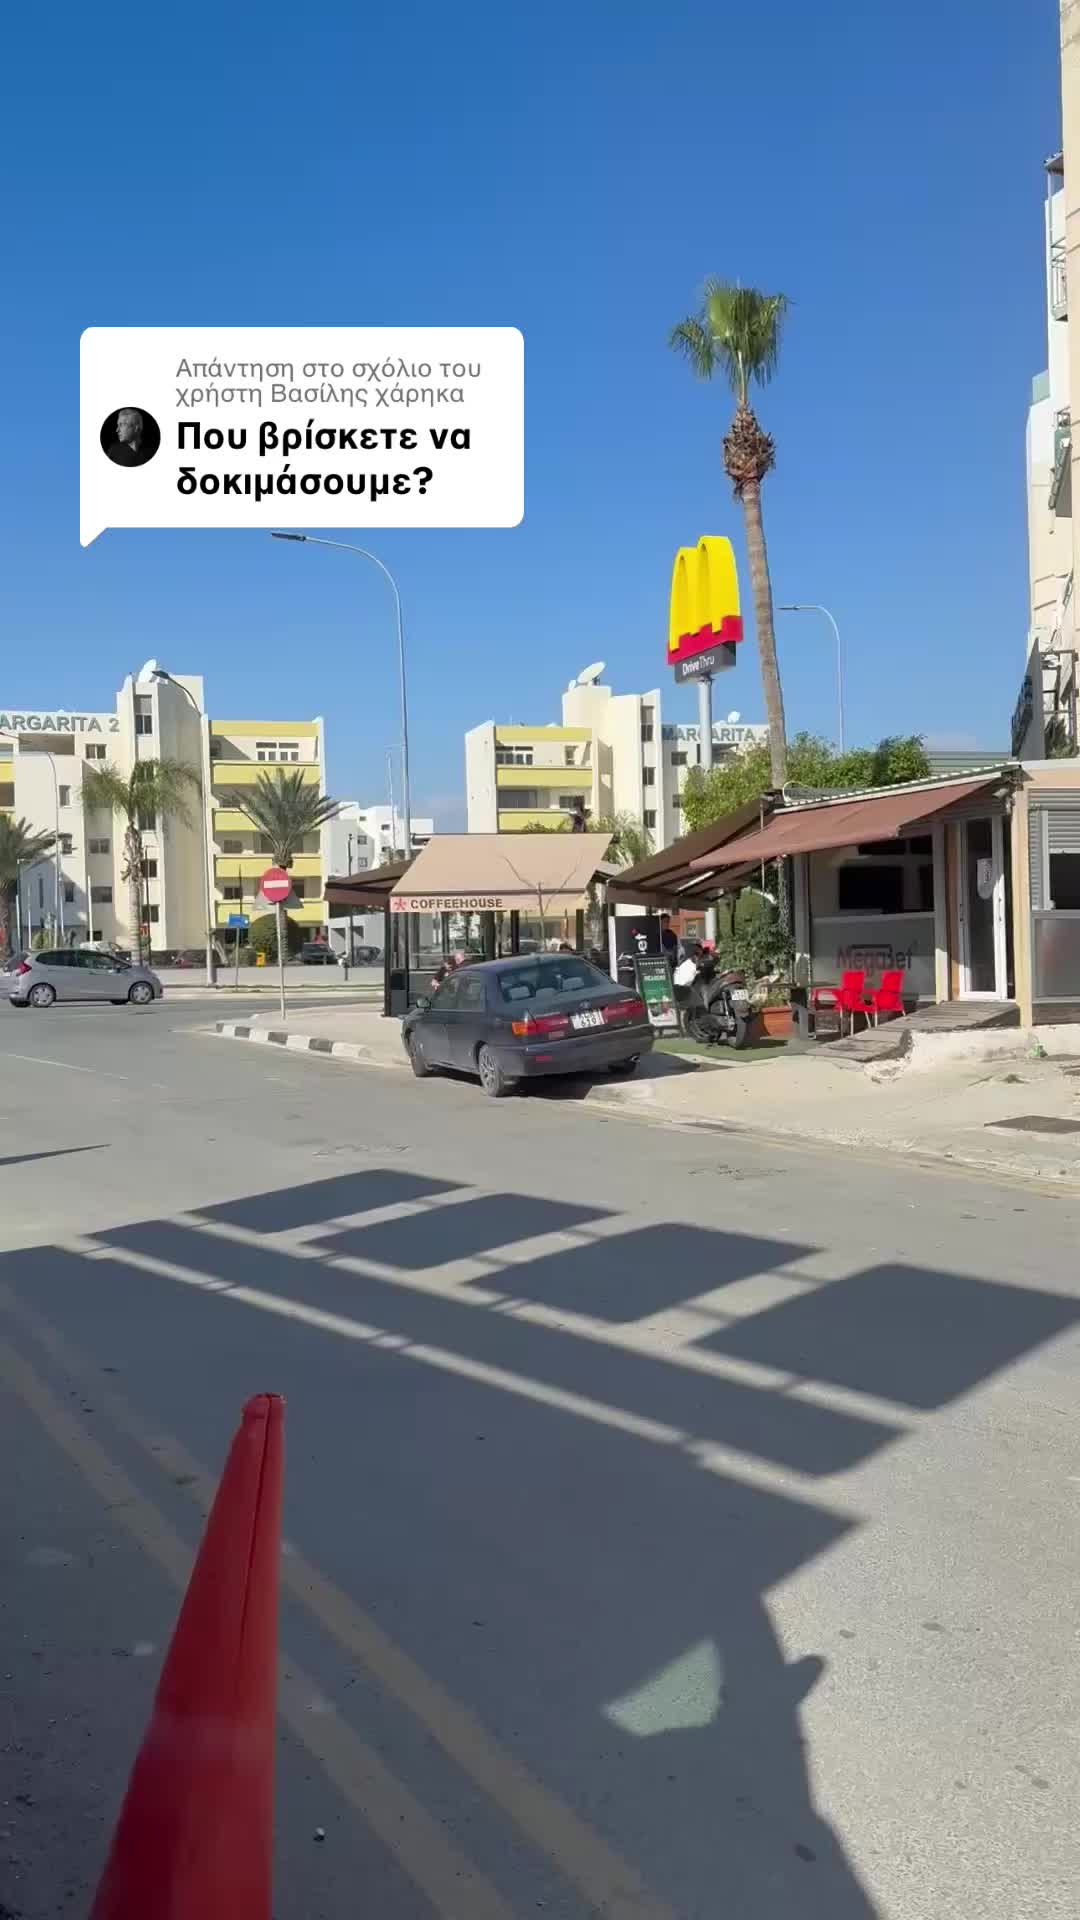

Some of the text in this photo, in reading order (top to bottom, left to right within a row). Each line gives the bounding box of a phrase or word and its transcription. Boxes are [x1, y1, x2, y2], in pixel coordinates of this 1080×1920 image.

[109, 717, 120, 732] 2
[662, 727, 756, 743] MARARITA
[410, 898, 503, 909] COFFEEHOUSE
